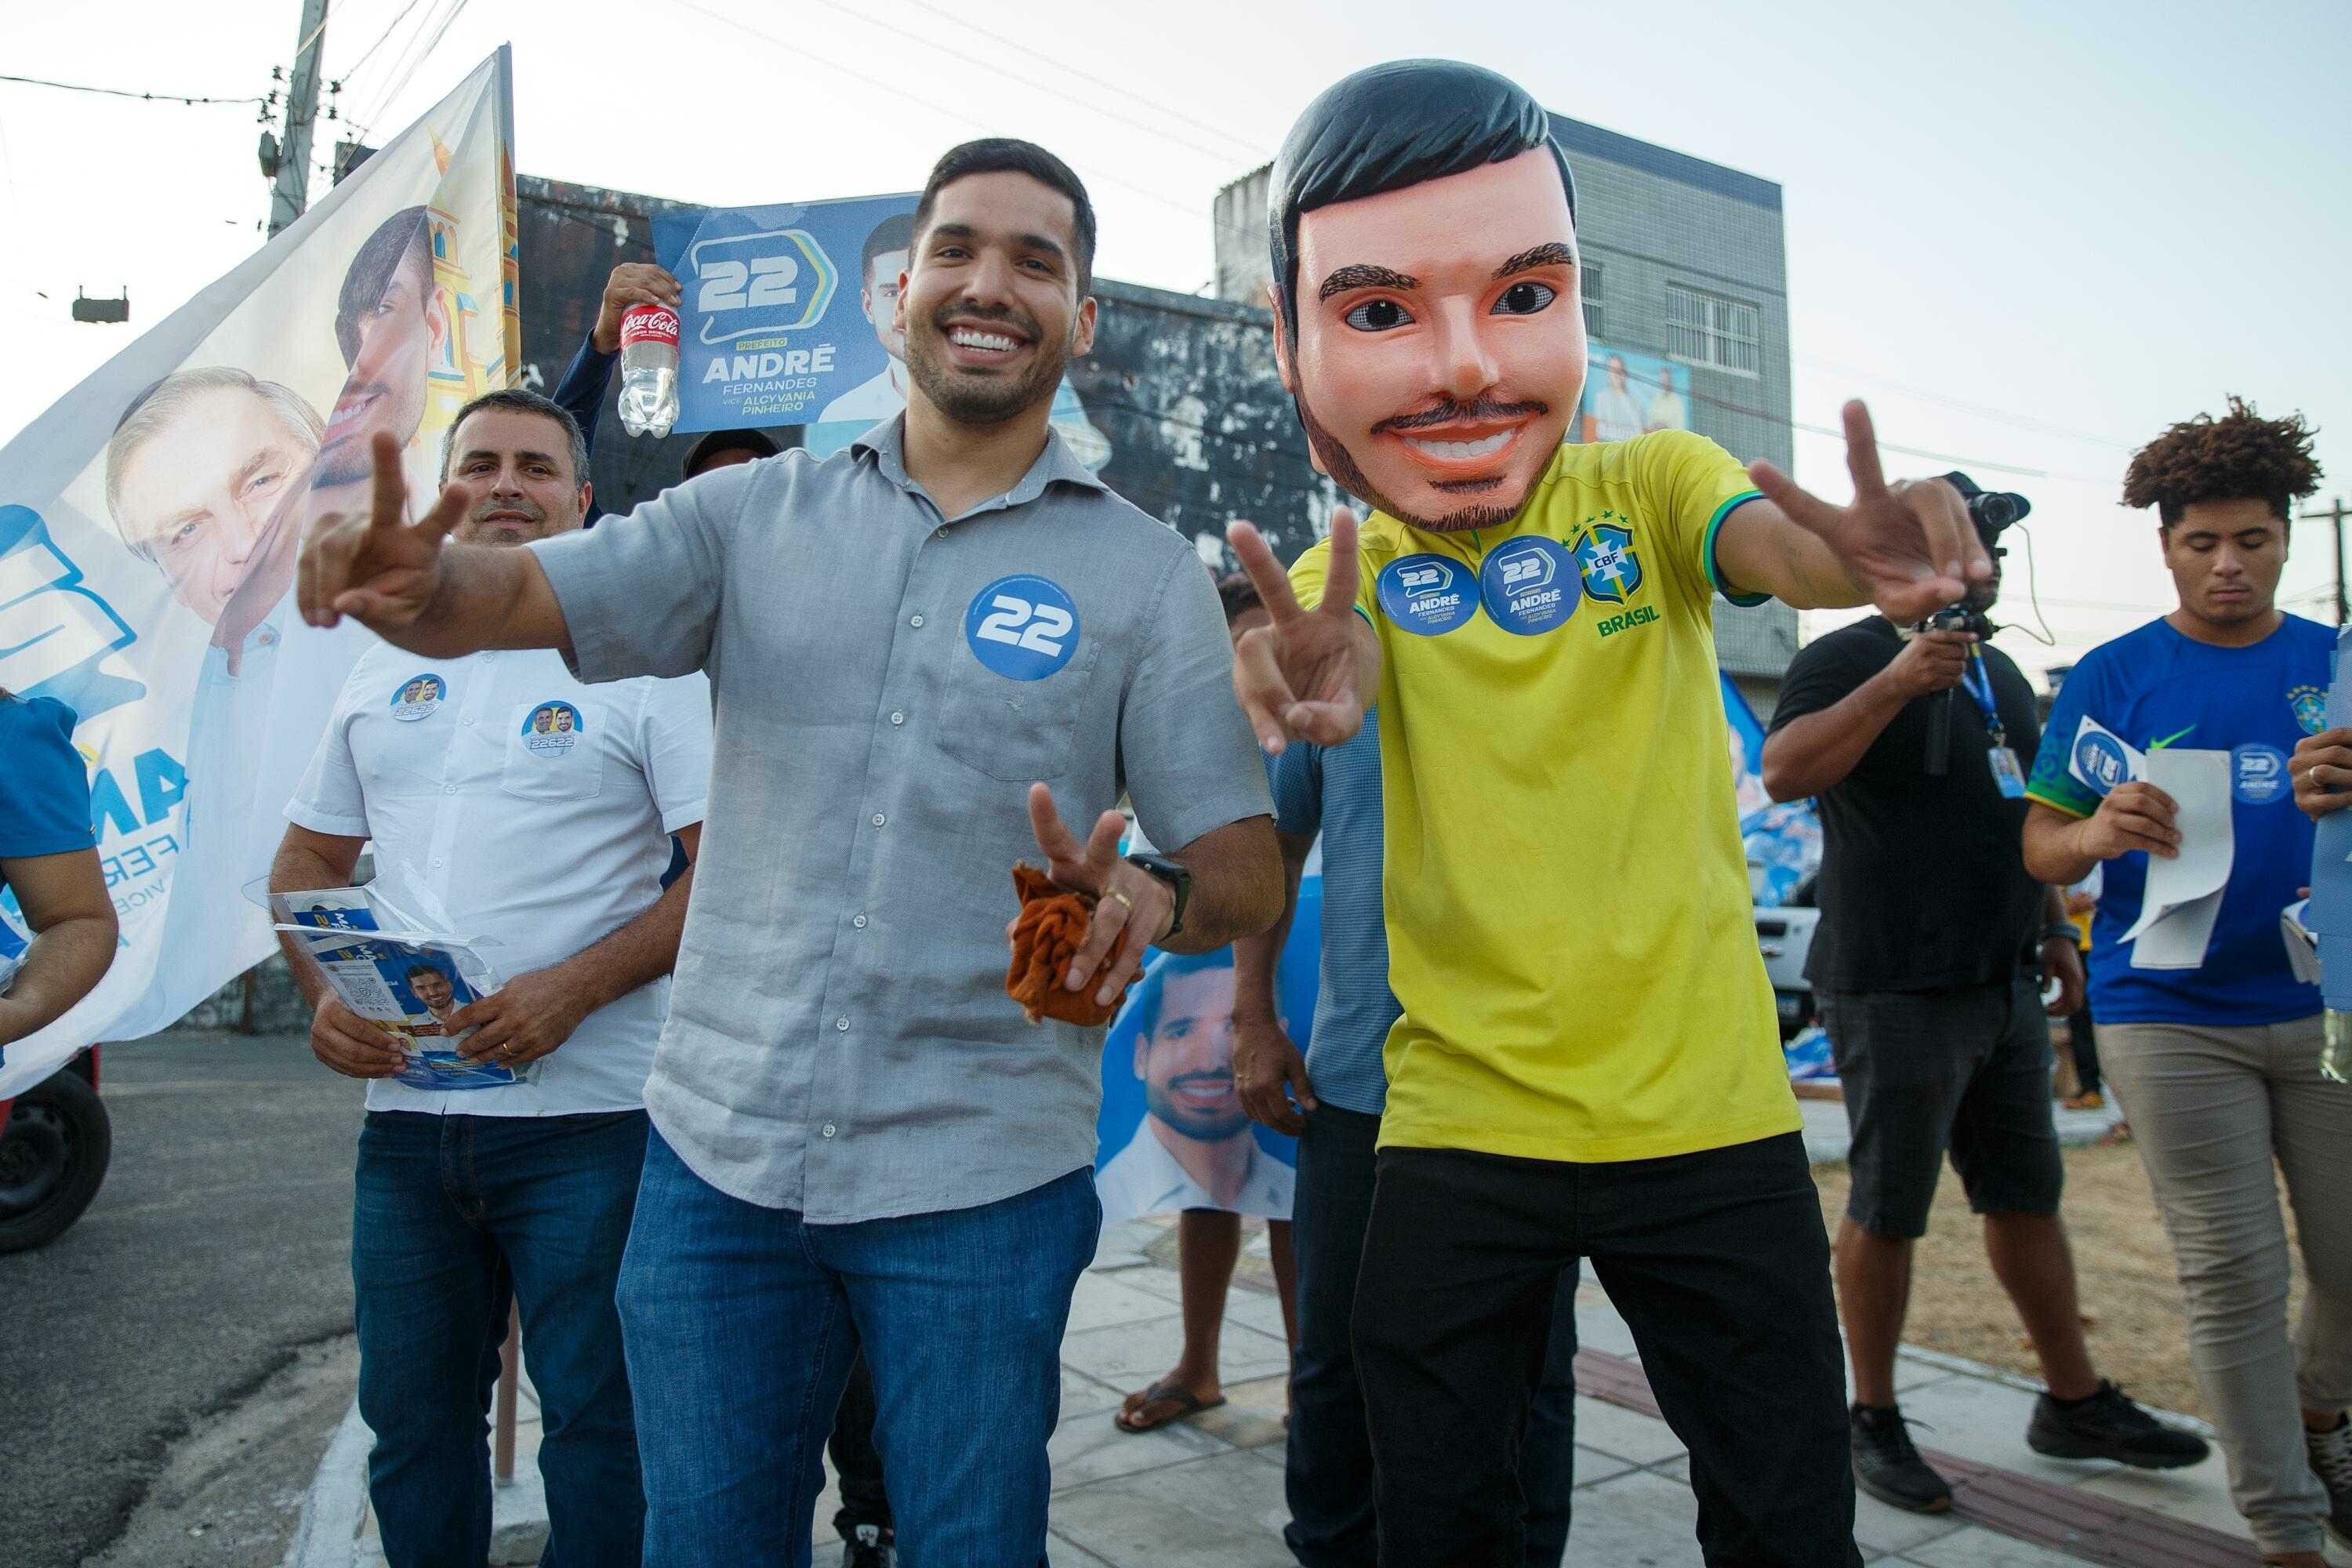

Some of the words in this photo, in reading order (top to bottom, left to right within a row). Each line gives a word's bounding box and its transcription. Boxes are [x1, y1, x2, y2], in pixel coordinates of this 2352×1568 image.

[698, 256, 798, 312] 22
[622, 312, 679, 337] Coca-Cola
[702, 343, 837, 383] ANDRÉ
[723, 377, 817, 395] FERNANDES
[742, 401, 804, 416] PINHEIRO
[1503, 557, 1541, 584] 22
[1594, 552, 1619, 569] CBF
[1401, 568, 1439, 587] 22
[1409, 593, 1461, 613] ANDRÉ
[1509, 588, 1562, 613] ANDRÉ
[976, 594, 1073, 657] 22
[1597, 605, 1661, 637] BRASIL
[531, 737, 575, 750] 22622
